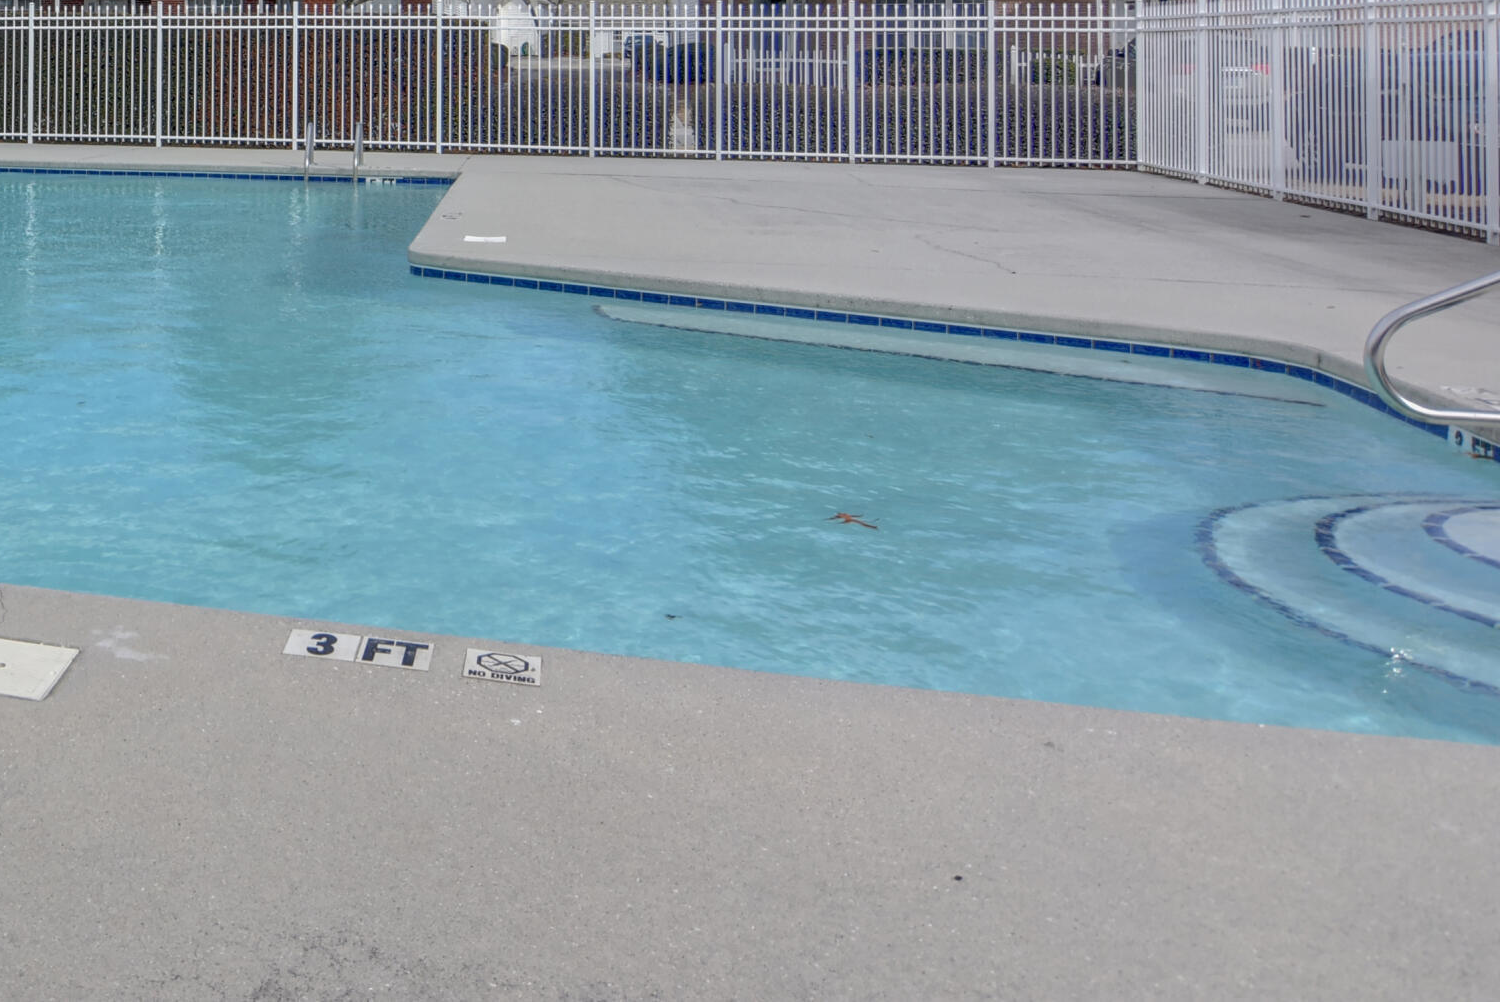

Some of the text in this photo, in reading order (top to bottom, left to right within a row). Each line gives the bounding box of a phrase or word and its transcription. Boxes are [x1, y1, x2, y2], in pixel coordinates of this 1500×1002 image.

[306, 633, 429, 666] 3 FT
[468, 669, 536, 684] NO DIVING
